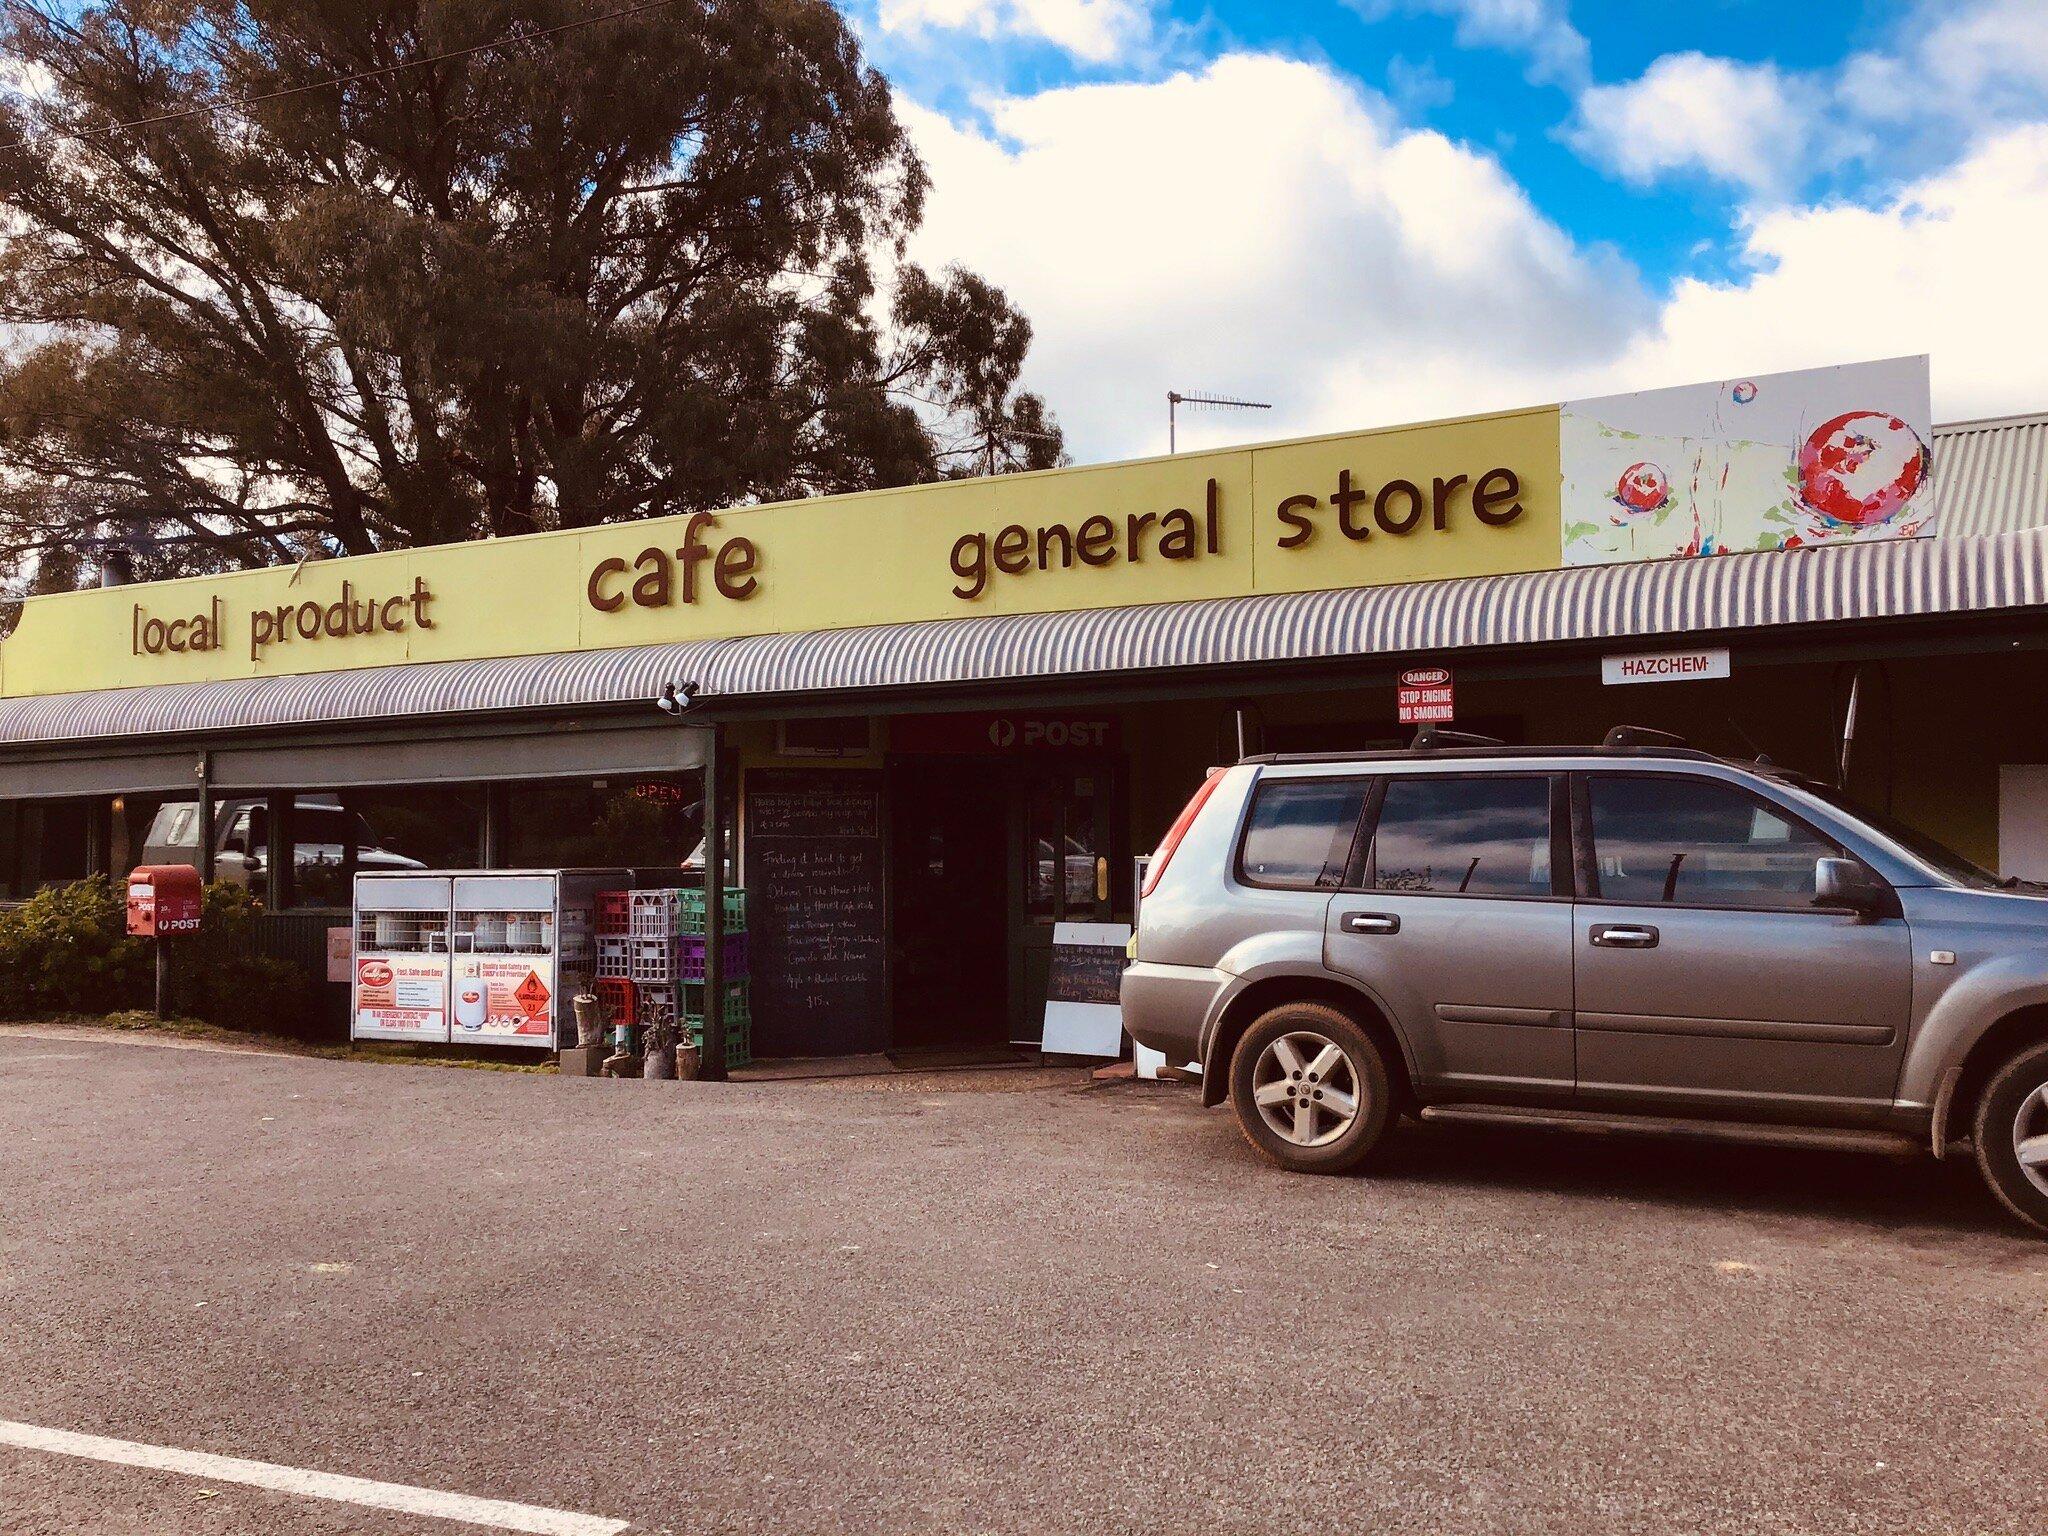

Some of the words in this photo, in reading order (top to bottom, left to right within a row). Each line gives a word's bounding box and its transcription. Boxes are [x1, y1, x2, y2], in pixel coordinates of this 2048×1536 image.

[950, 478, 1218, 599] general
[1277, 468, 1523, 548] store
[588, 512, 757, 611] cafe
[133, 595, 218, 656] local
[251, 576, 431, 662] product
[1623, 656, 1707, 675] HAZCHEM
[1407, 671, 1443, 682] DANGER
[1400, 690, 1420, 704] STOP
[1422, 689, 1452, 703] ENGINE
[1399, 707, 1412, 720] NO
[1413, 705, 1453, 720] SMOKING
[1024, 720, 1110, 747] POST
[637, 785, 682, 800] OPEN
[172, 919, 201, 929] POST
